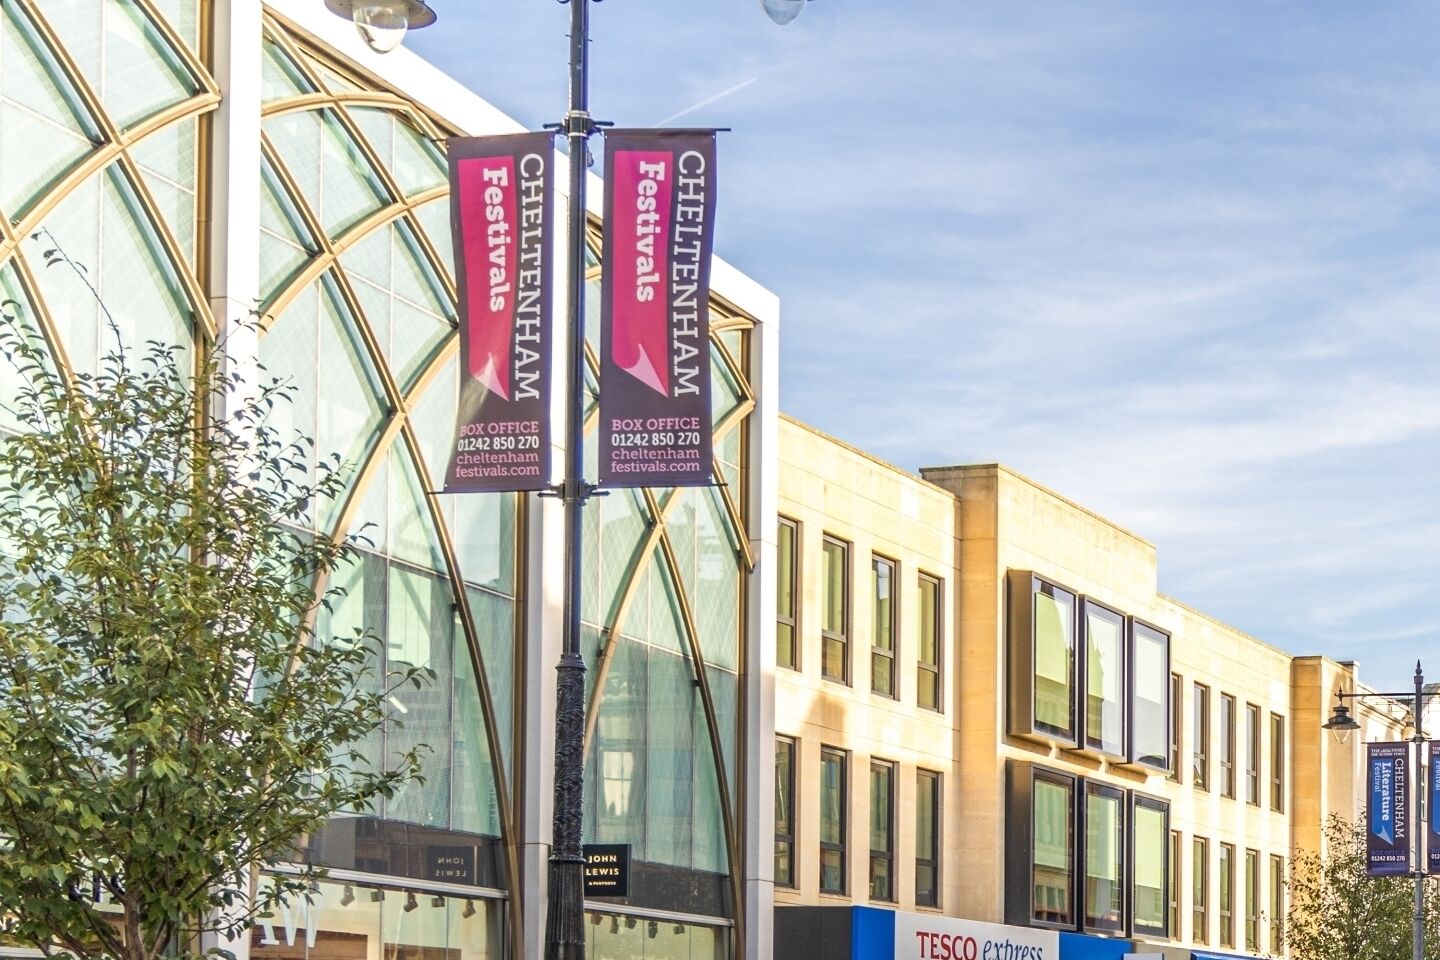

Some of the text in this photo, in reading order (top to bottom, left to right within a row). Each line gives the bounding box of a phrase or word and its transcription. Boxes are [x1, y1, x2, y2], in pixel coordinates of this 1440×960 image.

[483, 167, 512, 313] Festivals
[636, 161, 666, 303] Festivals
[515, 153, 545, 402] CHELTENHAM
[673, 151, 706, 397] CHELTENHAM
[460, 421, 540, 437] BOX OFFICE
[611, 417, 700, 431] BOX OFFICE
[457, 435, 540, 451] 01242 850 270
[611, 431, 700, 446] 01242 850 270
[456, 451, 540, 465] cheltenham
[611, 447, 700, 460] cheltenham
[456, 464, 540, 478] festivals.com
[611, 460, 700, 473] festivals.com
[1374, 763, 1382, 792] Festival
[1381, 762, 1392, 821] Literature
[1395, 758, 1405, 838] CHELTENHAM
[588, 855, 617, 864] JOHN
[585, 868, 620, 876] LEWIS
